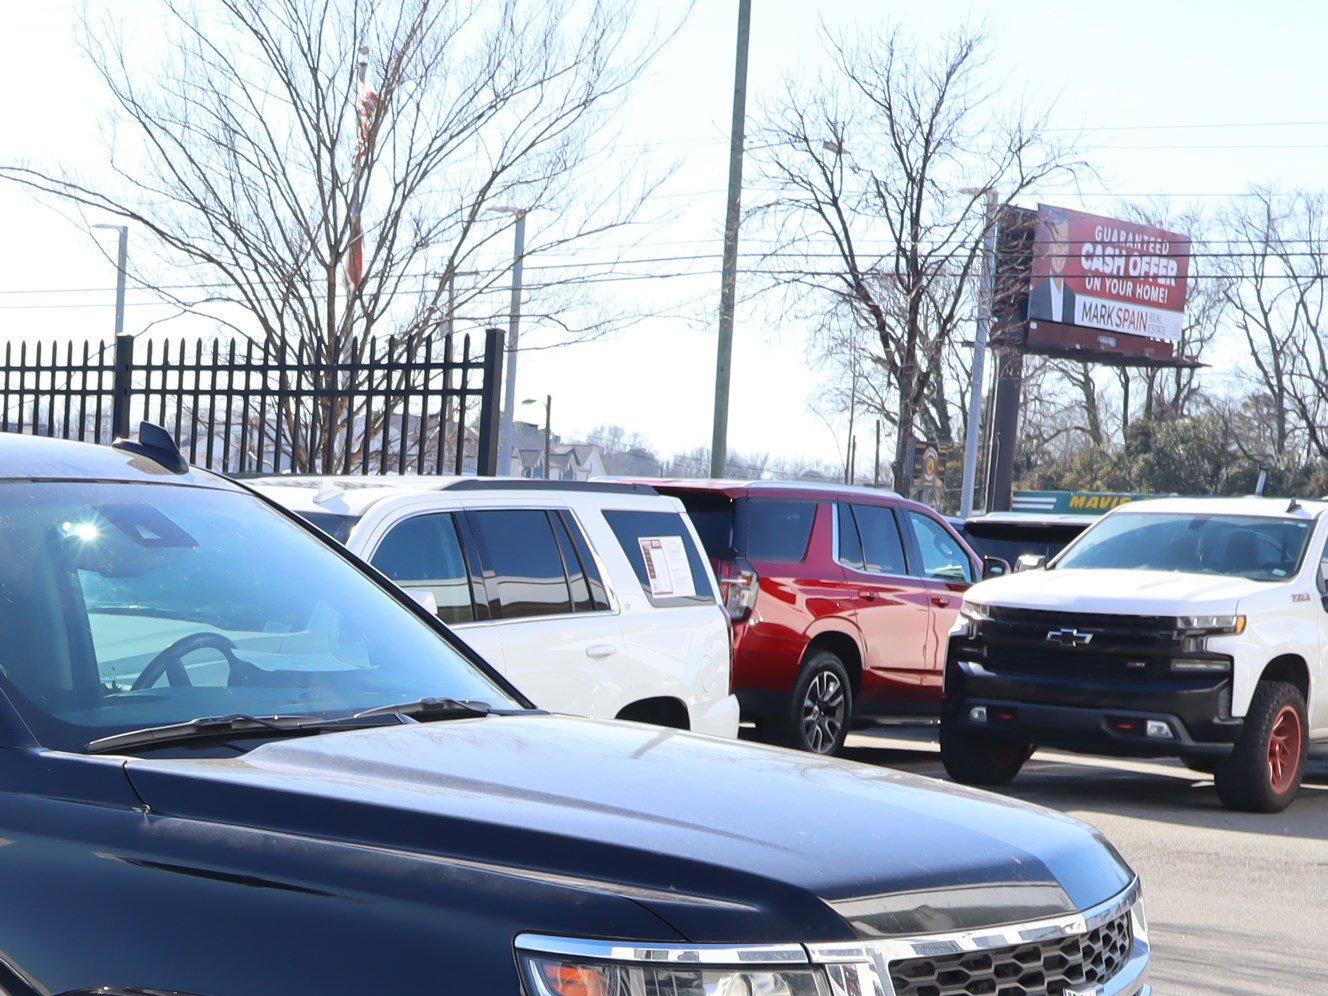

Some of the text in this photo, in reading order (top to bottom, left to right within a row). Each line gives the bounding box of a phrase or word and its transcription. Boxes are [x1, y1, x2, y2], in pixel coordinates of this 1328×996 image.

[1095, 225, 1170, 255] GUARANTEED
[1081, 242, 1178, 287] CASH OFFER
[1085, 274, 1169, 304] ON YOUR HOME!
[1081, 301, 1116, 327] MARK
[1115, 307, 1148, 332] SPAIN
